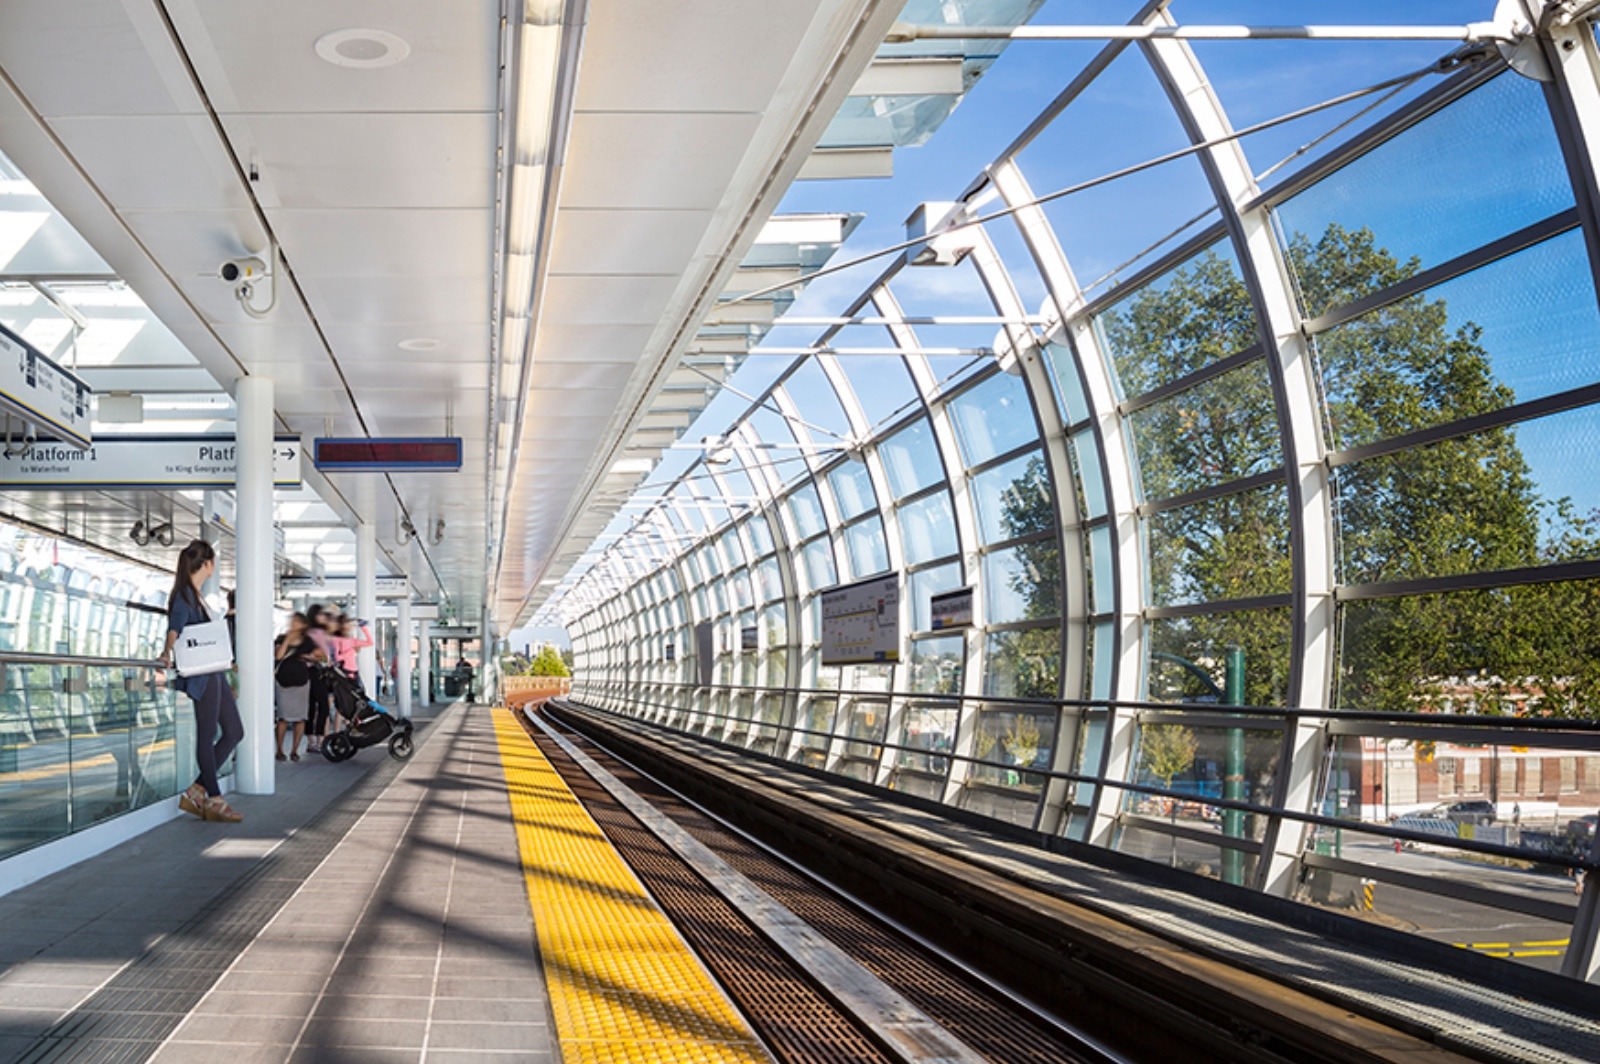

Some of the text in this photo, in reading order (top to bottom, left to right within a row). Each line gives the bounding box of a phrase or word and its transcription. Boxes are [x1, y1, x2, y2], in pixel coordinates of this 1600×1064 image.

[21, 447, 97, 461] Platform 1
[199, 446, 236, 461] Platf
[175, 464, 193, 474] King
[194, 464, 220, 474] George
